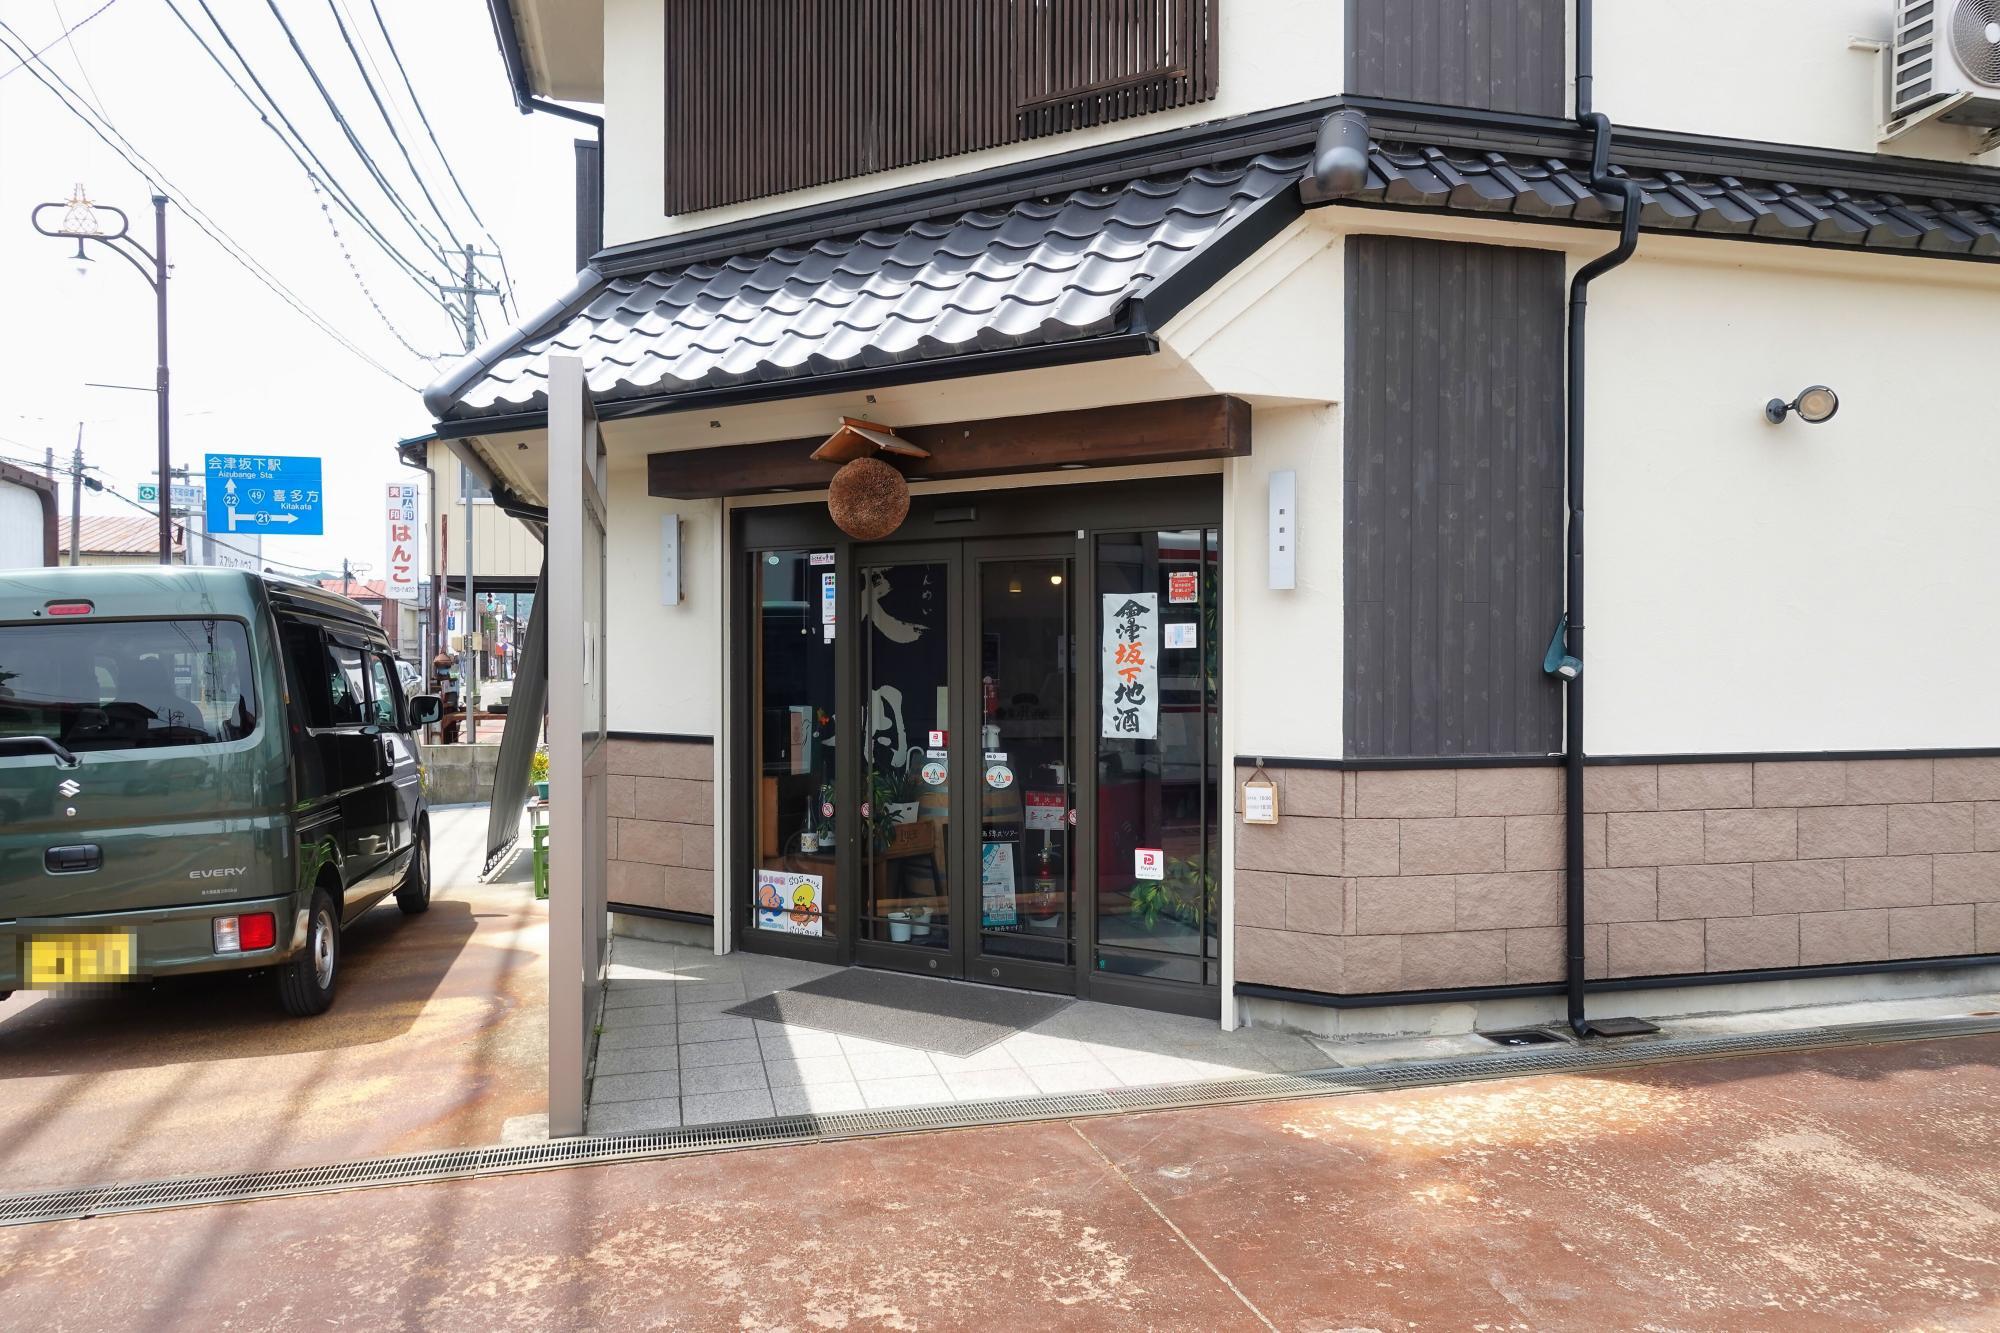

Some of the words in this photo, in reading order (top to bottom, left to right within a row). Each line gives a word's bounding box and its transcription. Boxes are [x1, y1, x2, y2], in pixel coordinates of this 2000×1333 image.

[208, 456, 282, 472] 会津坂下駅
[218, 471, 257, 480] Aizubange
[225, 496, 237, 505] 22
[251, 491, 262, 500] 49
[273, 489, 320, 503] 喜多方
[280, 502, 313, 511] Kitakata
[257, 513, 268, 523] 21
[391, 524, 412, 583] はんこ
[190, 866, 247, 879] EVERY
